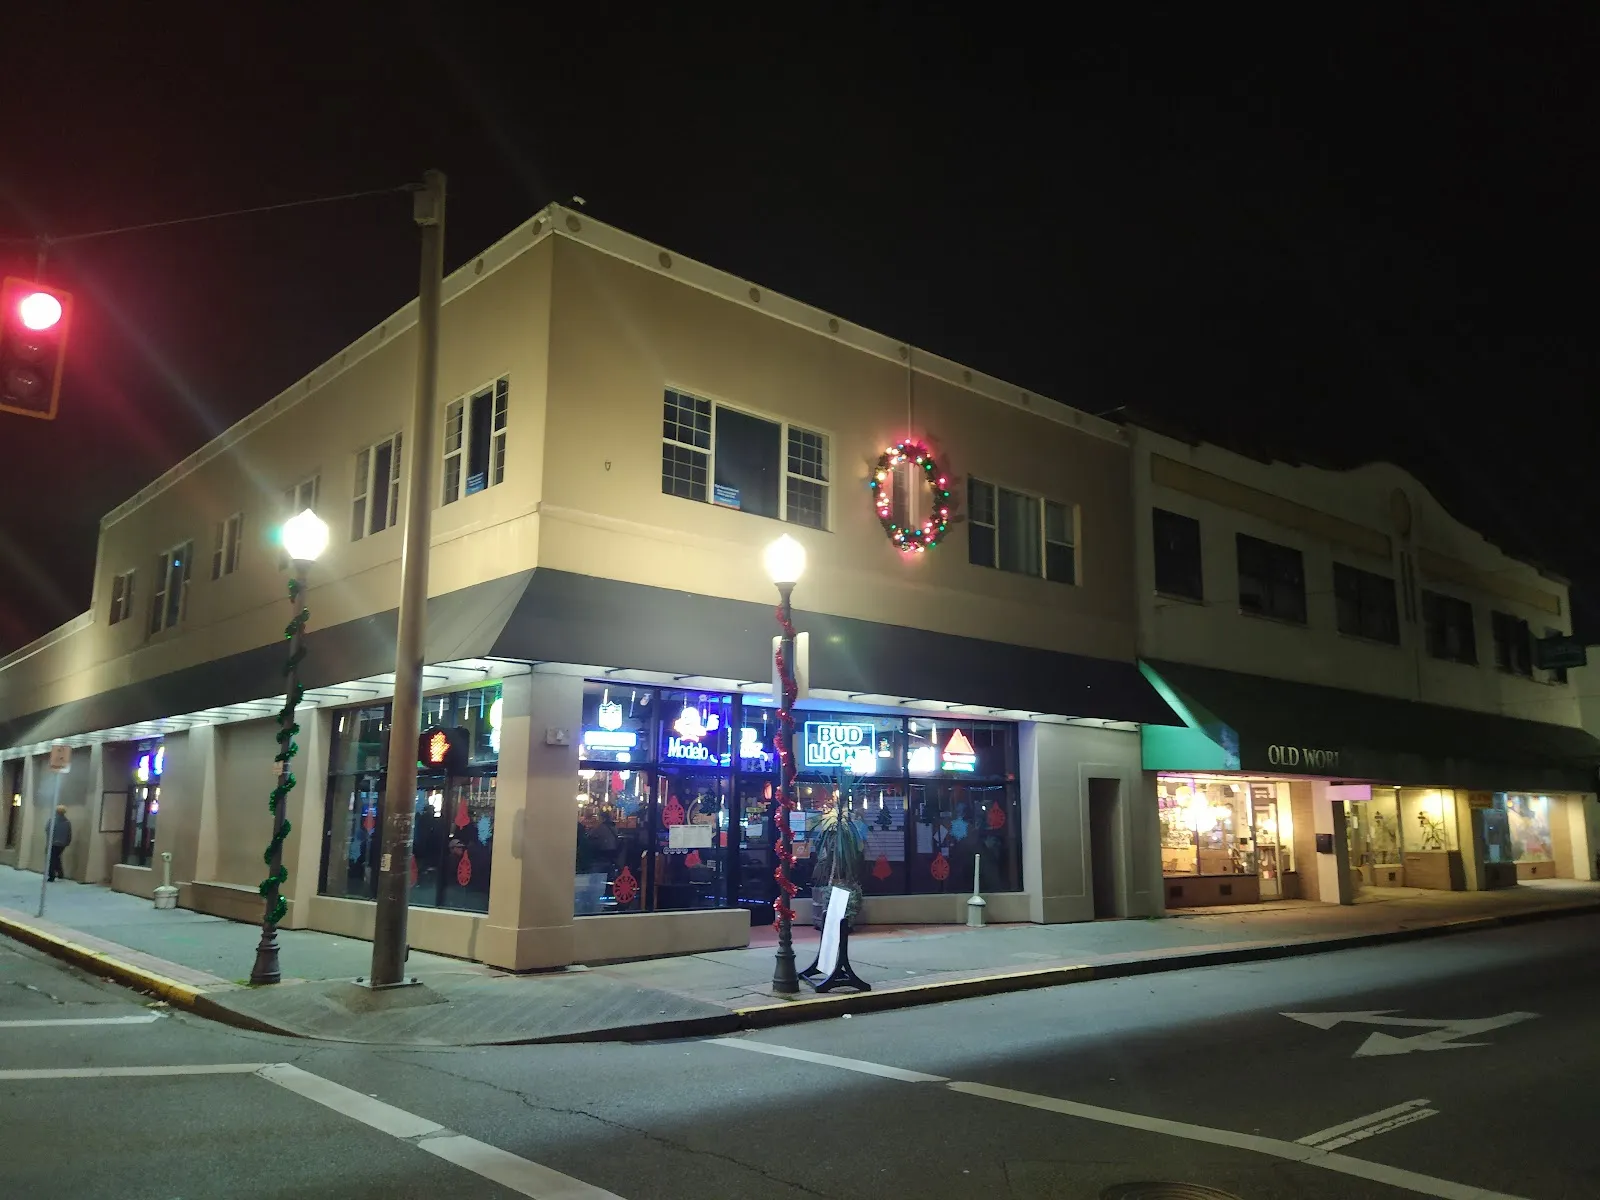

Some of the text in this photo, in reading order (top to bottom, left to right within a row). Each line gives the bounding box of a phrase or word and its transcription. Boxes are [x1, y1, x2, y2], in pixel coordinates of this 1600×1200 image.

[818, 725, 863, 745] BUD
[668, 736, 709, 760] Modelo
[809, 743, 872, 764] LIGH
[1267, 744, 1299, 766] OLD
